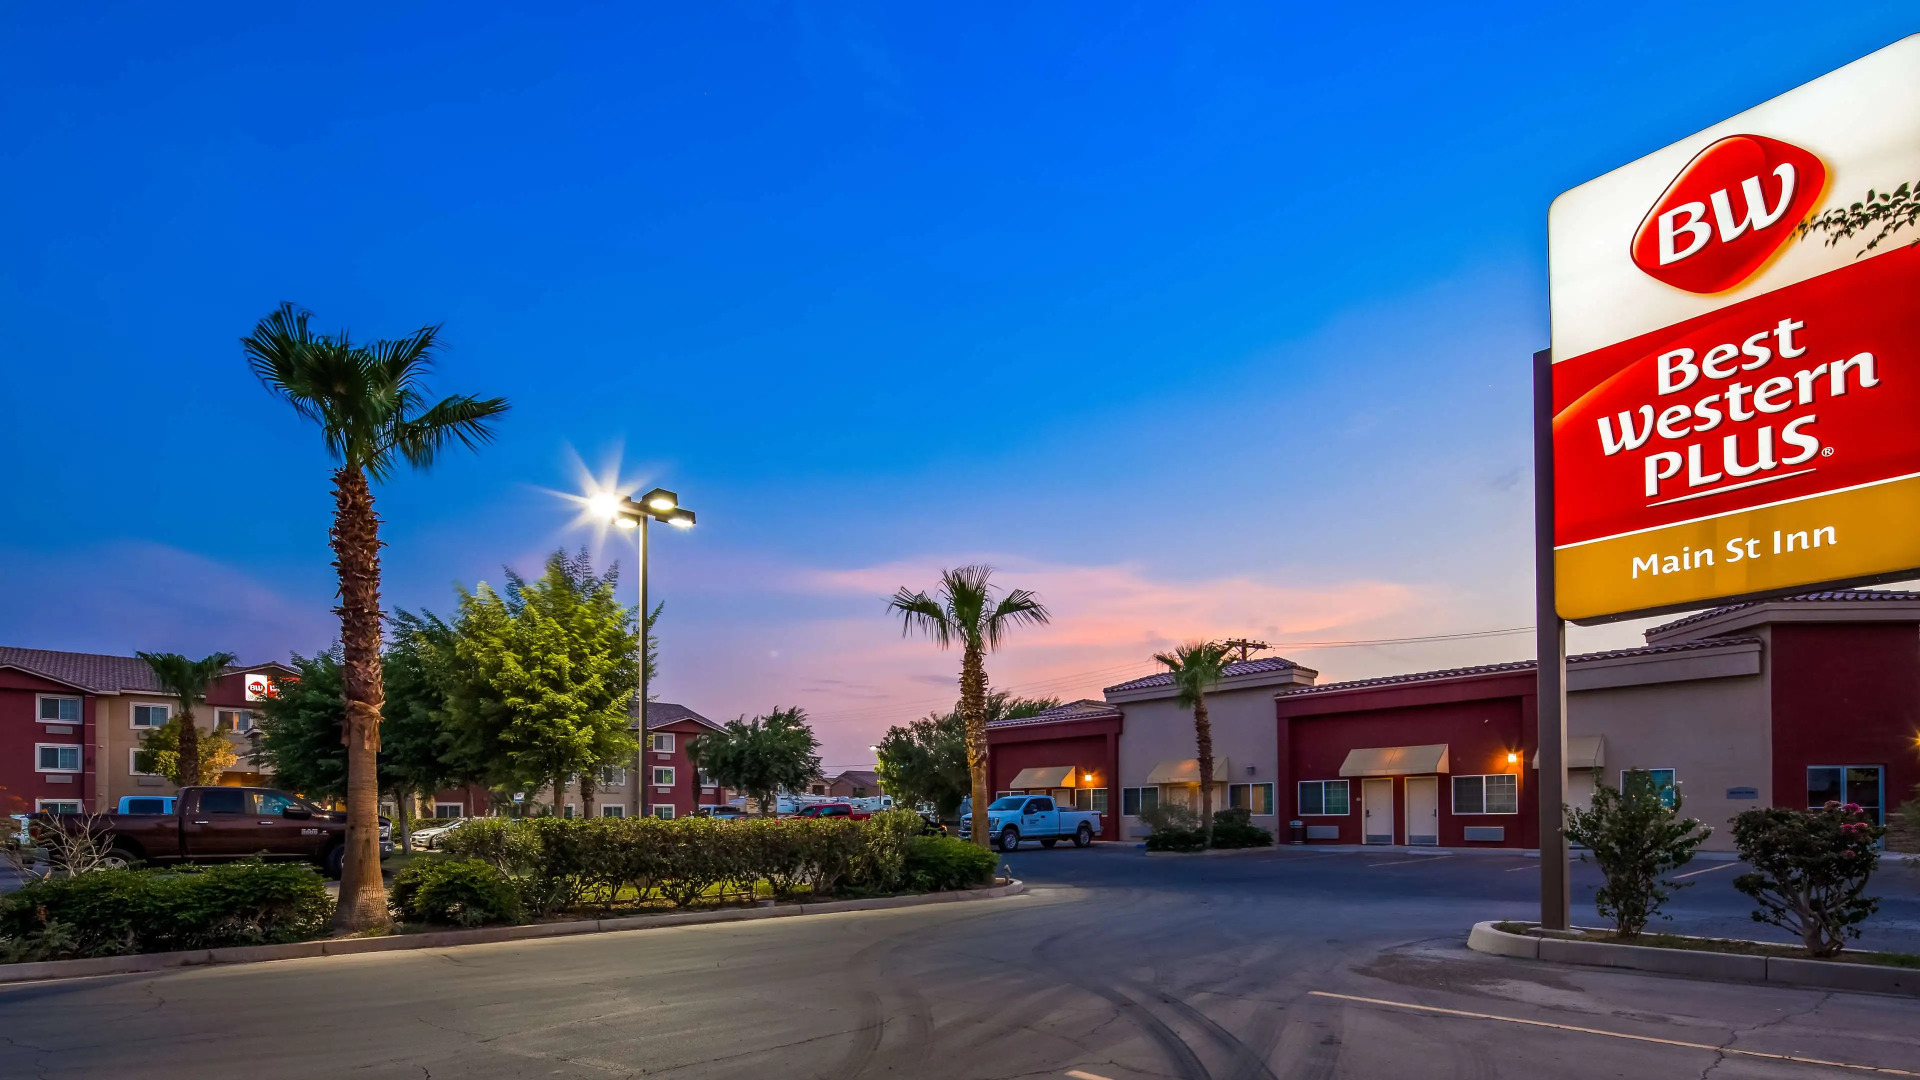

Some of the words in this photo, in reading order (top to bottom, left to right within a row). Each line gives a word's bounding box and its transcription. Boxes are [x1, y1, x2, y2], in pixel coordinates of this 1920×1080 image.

[1658, 162, 1796, 266] BW
[1657, 317, 1806, 396] Best
[1597, 351, 1880, 456] Western
[1632, 546, 1715, 580] Main
[1725, 537, 1761, 563] St
[1773, 525, 1838, 555] Inn
[249, 684, 264, 692] BW
